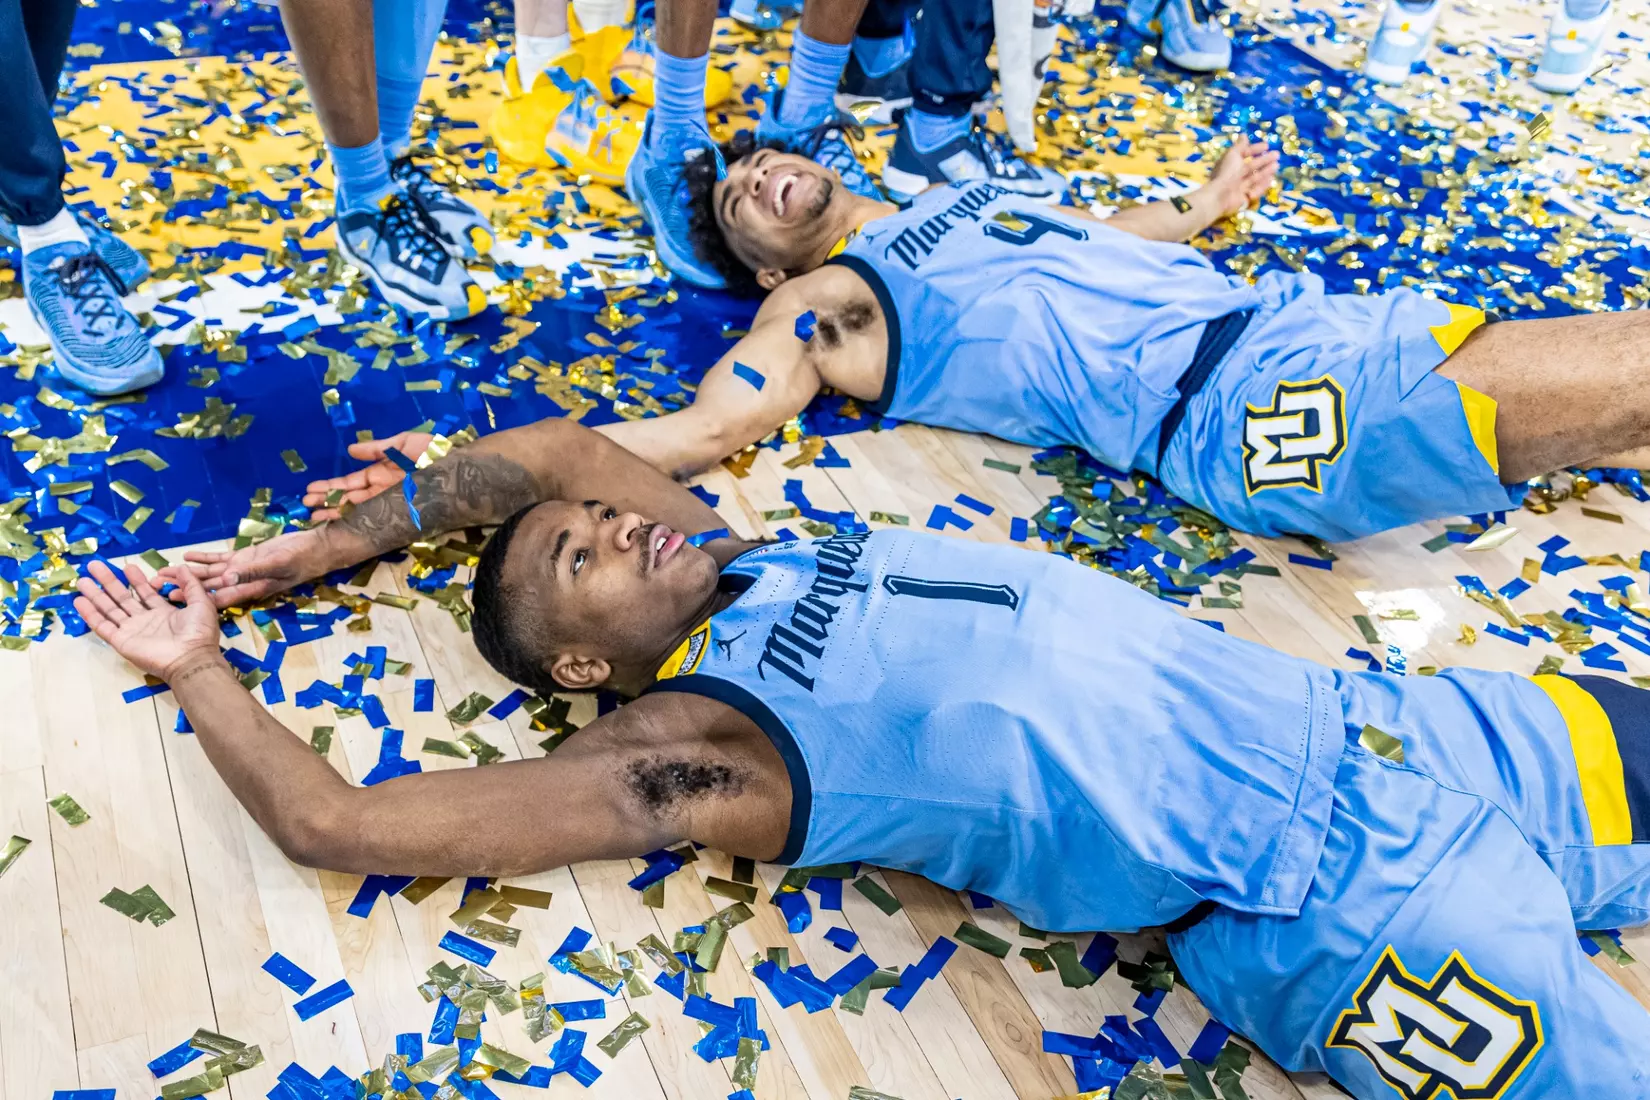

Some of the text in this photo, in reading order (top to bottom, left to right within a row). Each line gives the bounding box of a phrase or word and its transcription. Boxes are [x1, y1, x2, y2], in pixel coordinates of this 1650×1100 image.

[884, 183, 1013, 271] Marque
[982, 208, 1089, 246] 4
[1240, 373, 1348, 498] MU
[882, 574, 1019, 611] 1
[1325, 943, 1545, 1100] MU
